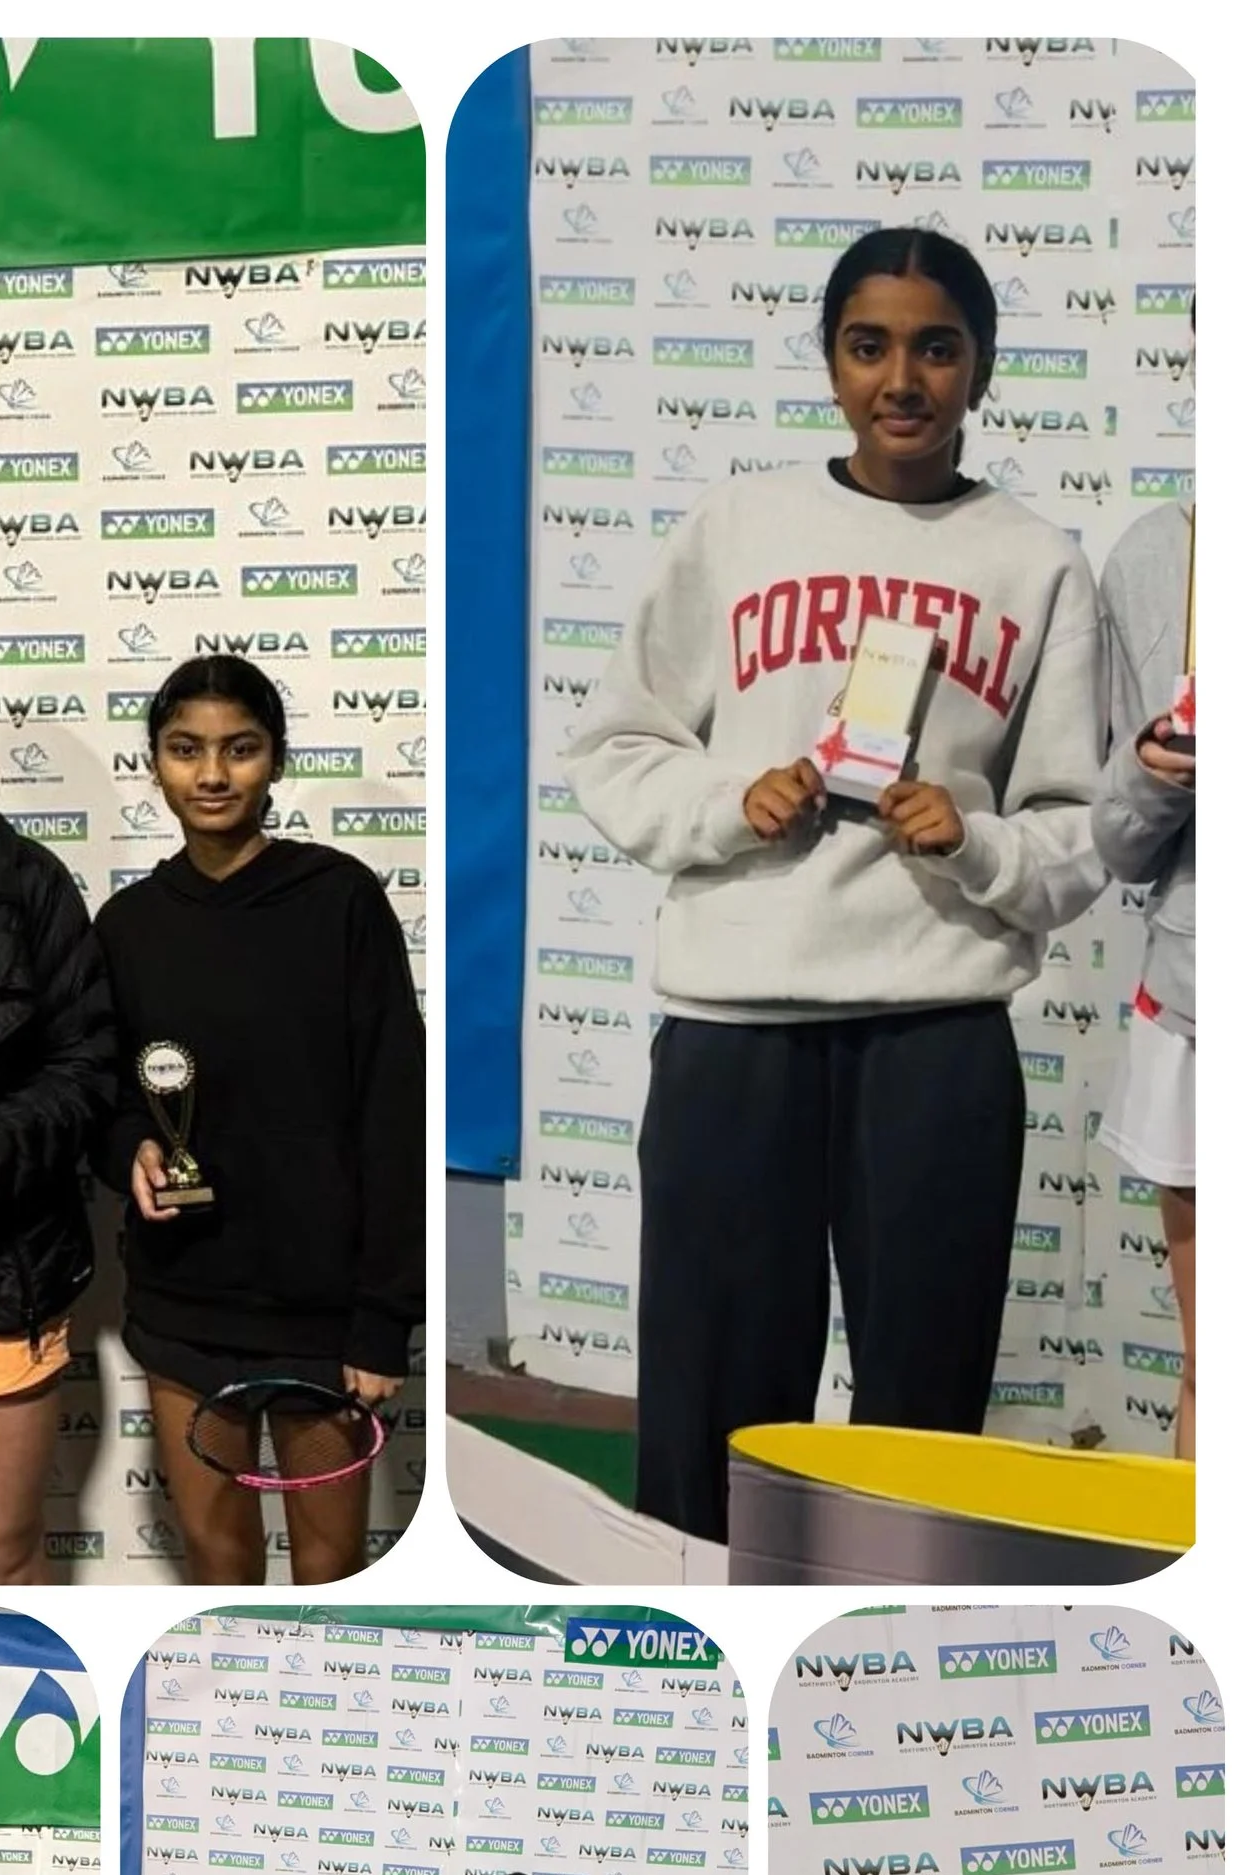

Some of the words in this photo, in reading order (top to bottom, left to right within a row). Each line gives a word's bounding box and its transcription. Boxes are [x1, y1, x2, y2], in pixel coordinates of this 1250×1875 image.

[574, 101, 628, 121] YONEX
[731, 97, 835, 120] NWBA
[858, 161, 961, 184] NWBA
[1026, 164, 1085, 188] YONEX
[656, 218, 752, 239] NWBA
[186, 263, 298, 287] NWBA
[543, 337, 634, 358] NWBA
[9, 456, 74, 478] YONEX
[286, 568, 352, 591] YONEX
[732, 575, 1020, 720] CORNELL
[627, 1629, 708, 1661] YONEX
[233, 1657, 265, 1670] YONEX
[324, 1664, 381, 1677] NWBA
[796, 1650, 917, 1678] NWBA
[985, 1647, 1048, 1671] YONEX
[567, 1674, 601, 1688] YONEX
[896, 1716, 1013, 1745] NWBA
[1079, 1711, 1142, 1735] YONEX
[1042, 1771, 1154, 1800] NWBA
[856, 1792, 921, 1816] YONEX
[955, 1808, 993, 1816] BADMINTON
[1006, 1847, 1067, 1869] YONEX
[1100, 1860, 1136, 1868] BADMINTON
